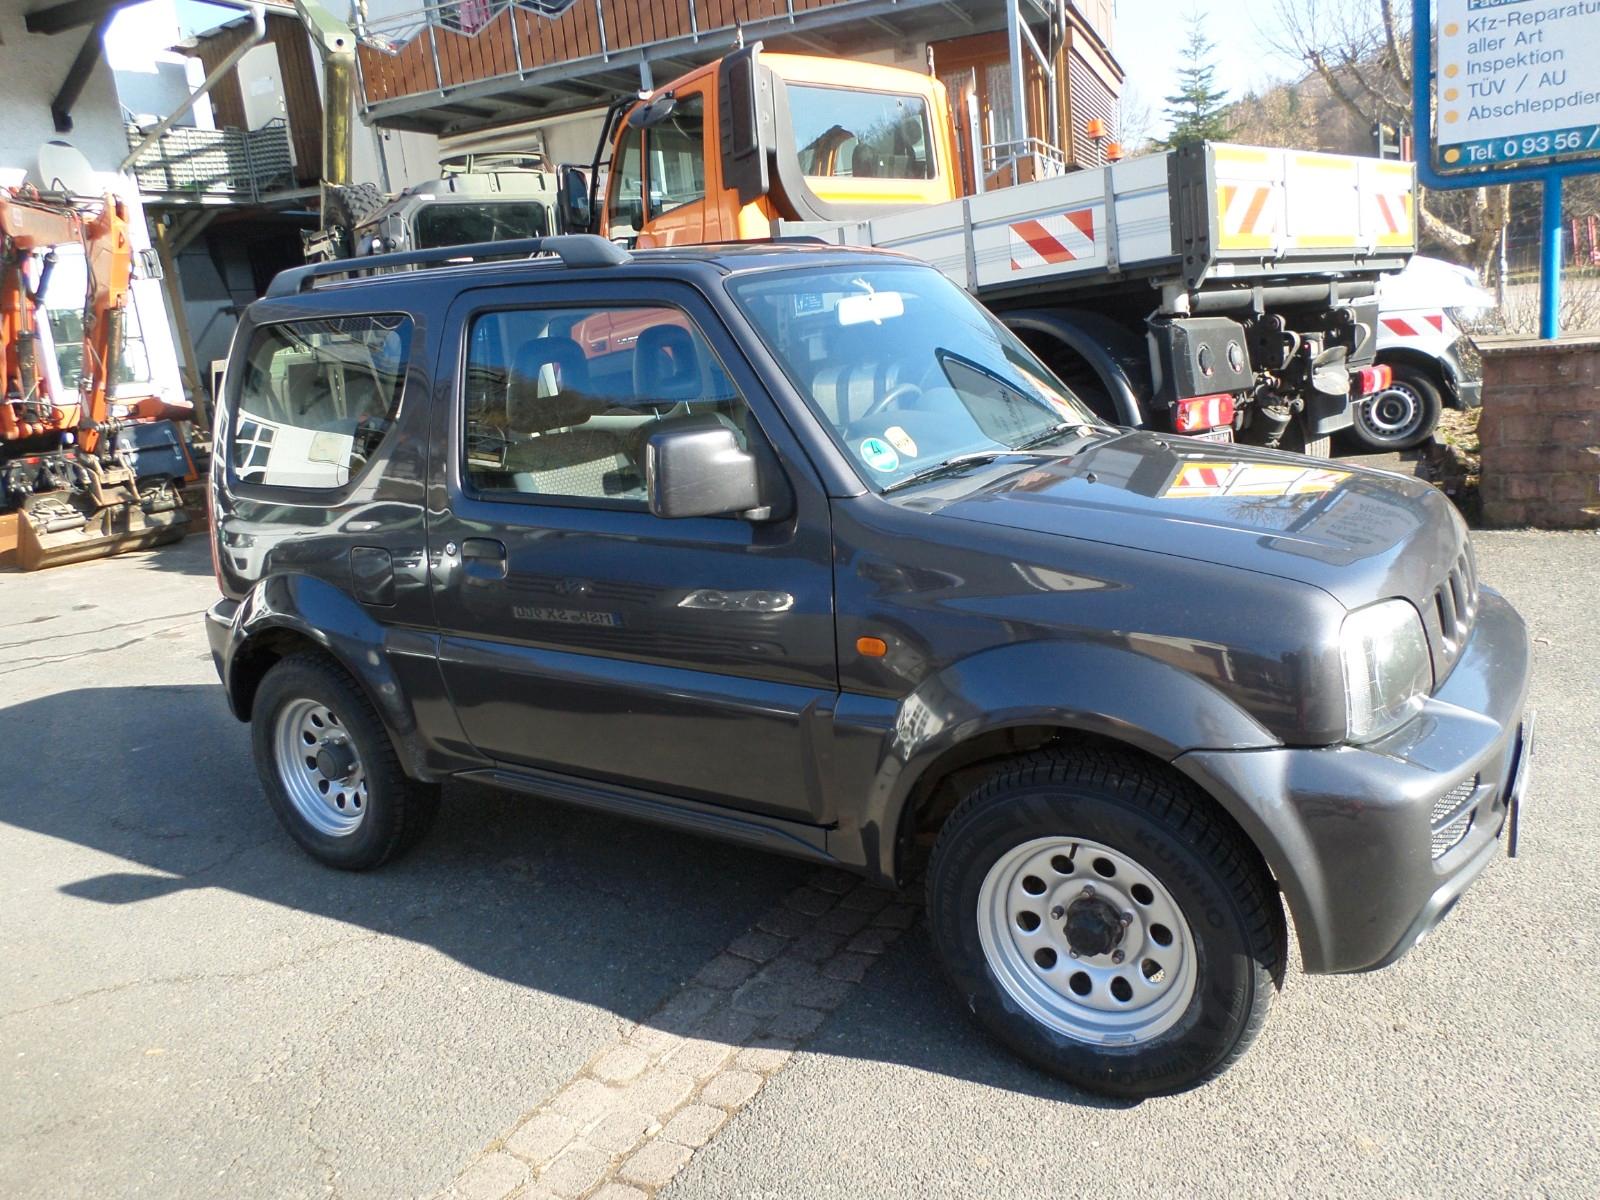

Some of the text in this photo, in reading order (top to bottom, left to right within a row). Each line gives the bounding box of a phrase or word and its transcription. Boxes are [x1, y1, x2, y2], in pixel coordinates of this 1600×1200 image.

[1467, 29, 1543, 55] aller Art
[1467, 49, 1564, 75] Inspektion
[1467, 78, 1506, 98] TÜV
[1538, 69, 1567, 88] AU
[1466, 143, 1496, 161] Tel.
